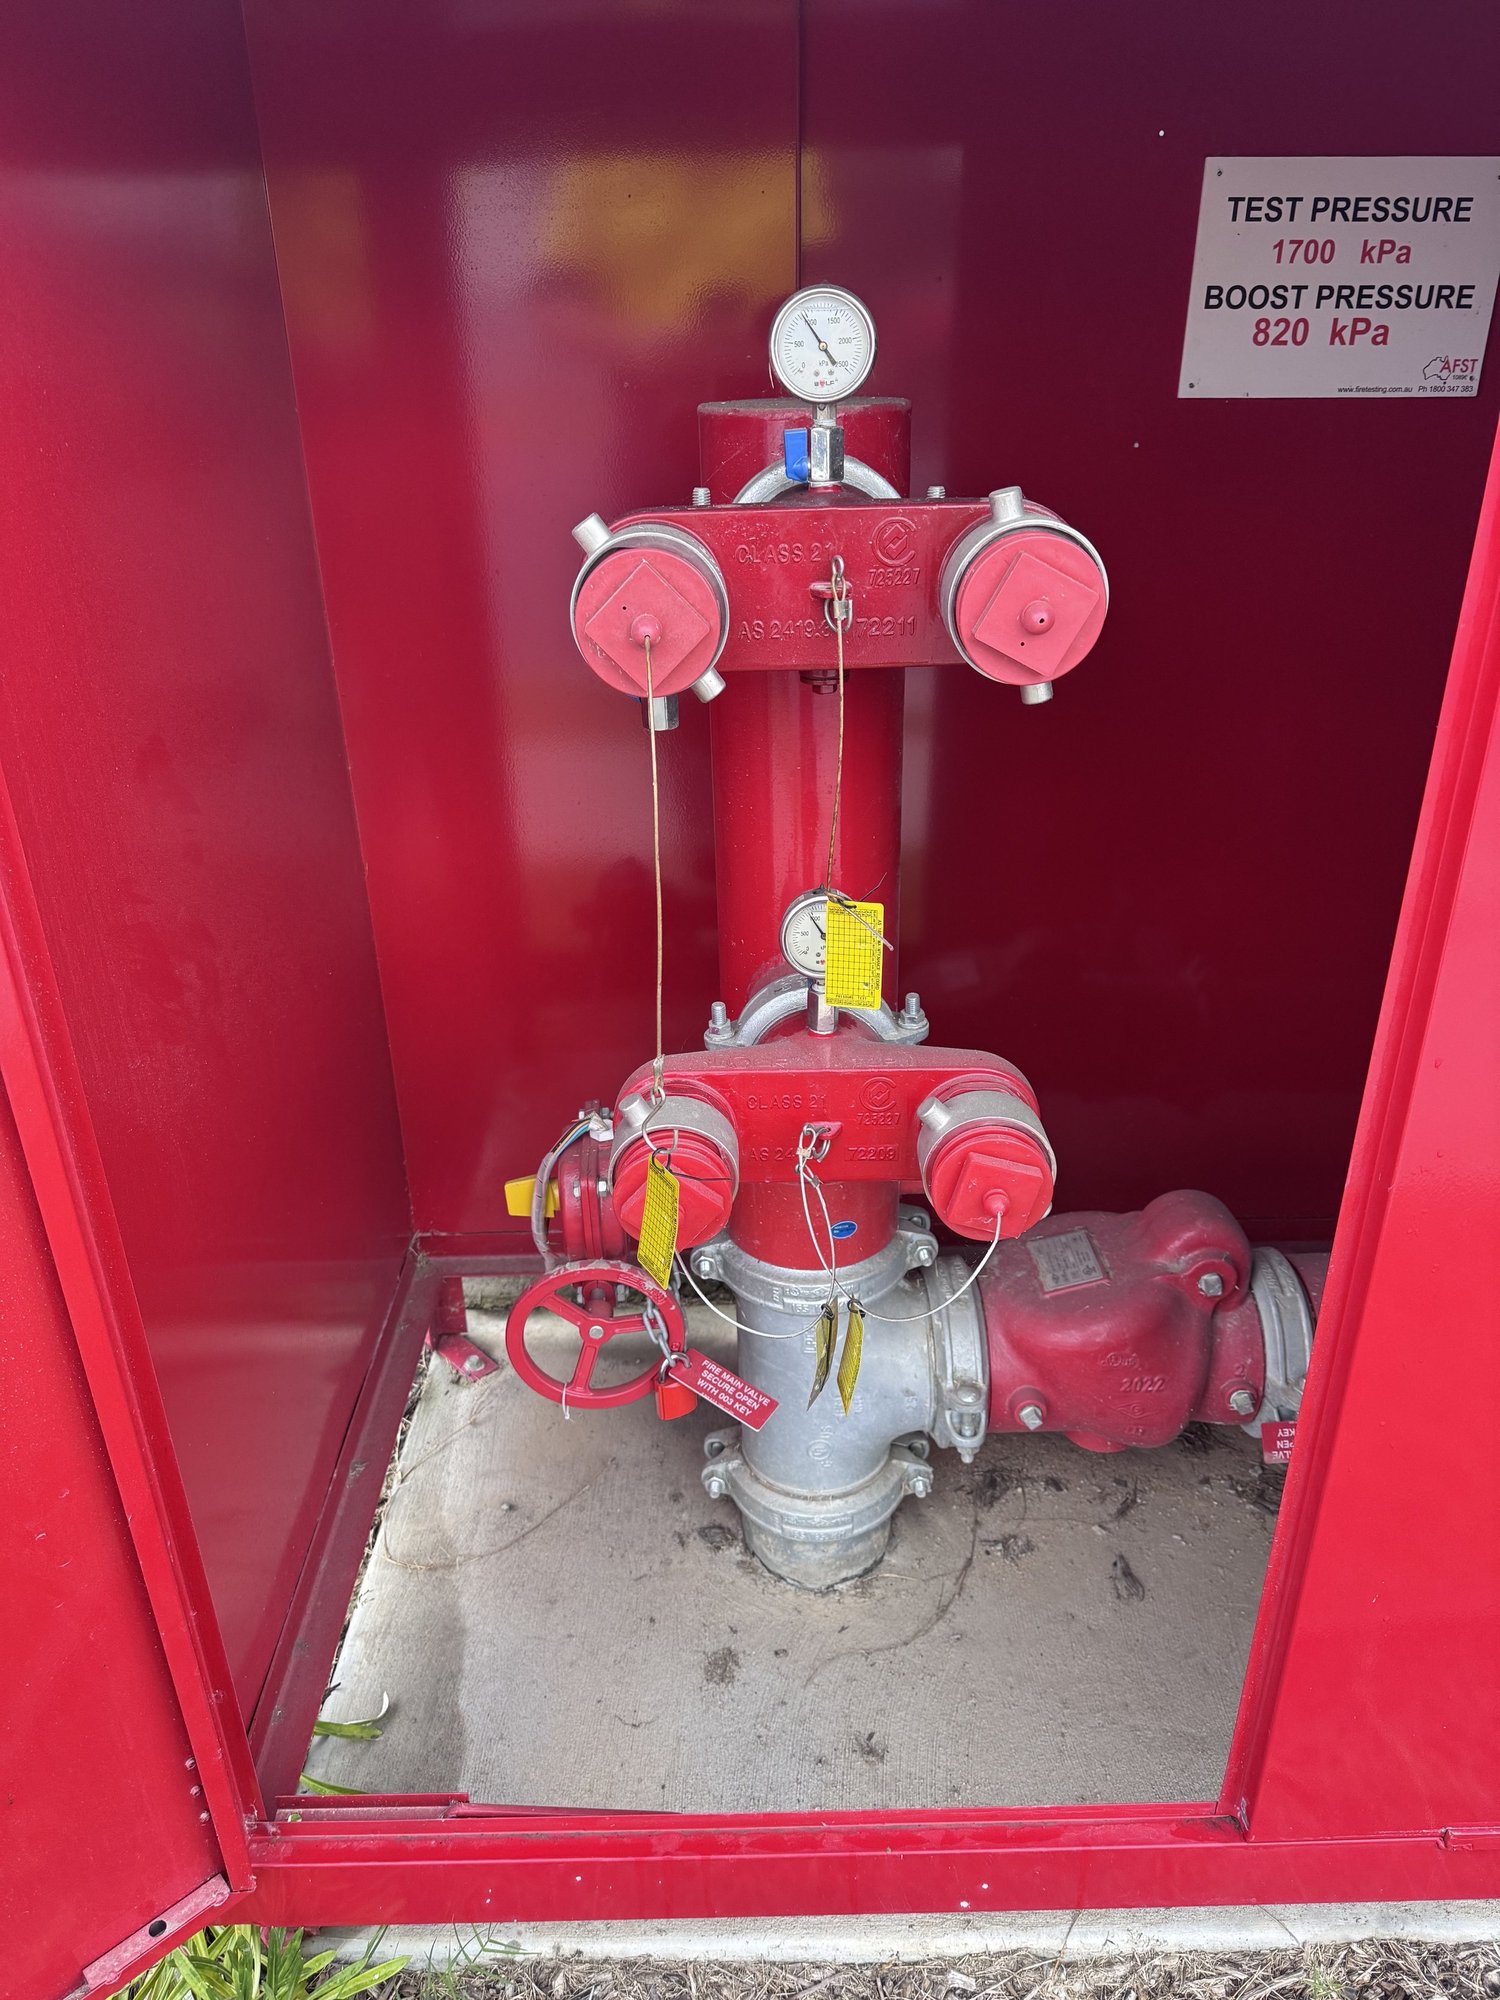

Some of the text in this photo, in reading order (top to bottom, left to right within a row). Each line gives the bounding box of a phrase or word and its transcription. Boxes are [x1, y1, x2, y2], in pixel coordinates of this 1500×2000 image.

[1228, 196, 1474, 222] TEST PRESSURE
[1272, 238, 1412, 265] 1700 kPa
[1204, 284, 1476, 309] BOOST PRESSURE
[827, 317, 841, 325] 1500
[1252, 317, 1390, 346] 820 kPa
[838, 337, 853, 345] 2000
[1440, 358, 1479, 374] AFST
[1337, 385, 1474, 394] www.firetesting.com.au Ph 1800 347 383
[736, 542, 832, 564] CLASS 21
[869, 568, 921, 587] 725227
[738, 620, 765, 640] AS
[856, 616, 917, 638] 72211
[747, 1094, 827, 1109] CLASS 21
[857, 1112, 900, 1126] 725227
[749, 1147, 769, 1161] AS
[701, 1360, 722, 1375] FIRE
[721, 1372, 744, 1389] MAIN
[744, 1386, 770, 1407] VALVE
[701, 1369, 736, 1395] SECURE
[735, 1391, 760, 1411] OPEN
[1120, 1376, 1166, 1393] 2022
[697, 1378, 719, 1395] WITH
[718, 1392, 734, 1406] 003
[733, 1401, 752, 1416] KEY
[1277, 1428, 1296, 1438] KEY
[1276, 1440, 1295, 1449] PEN
[1271, 1450, 1292, 1460] LVE
